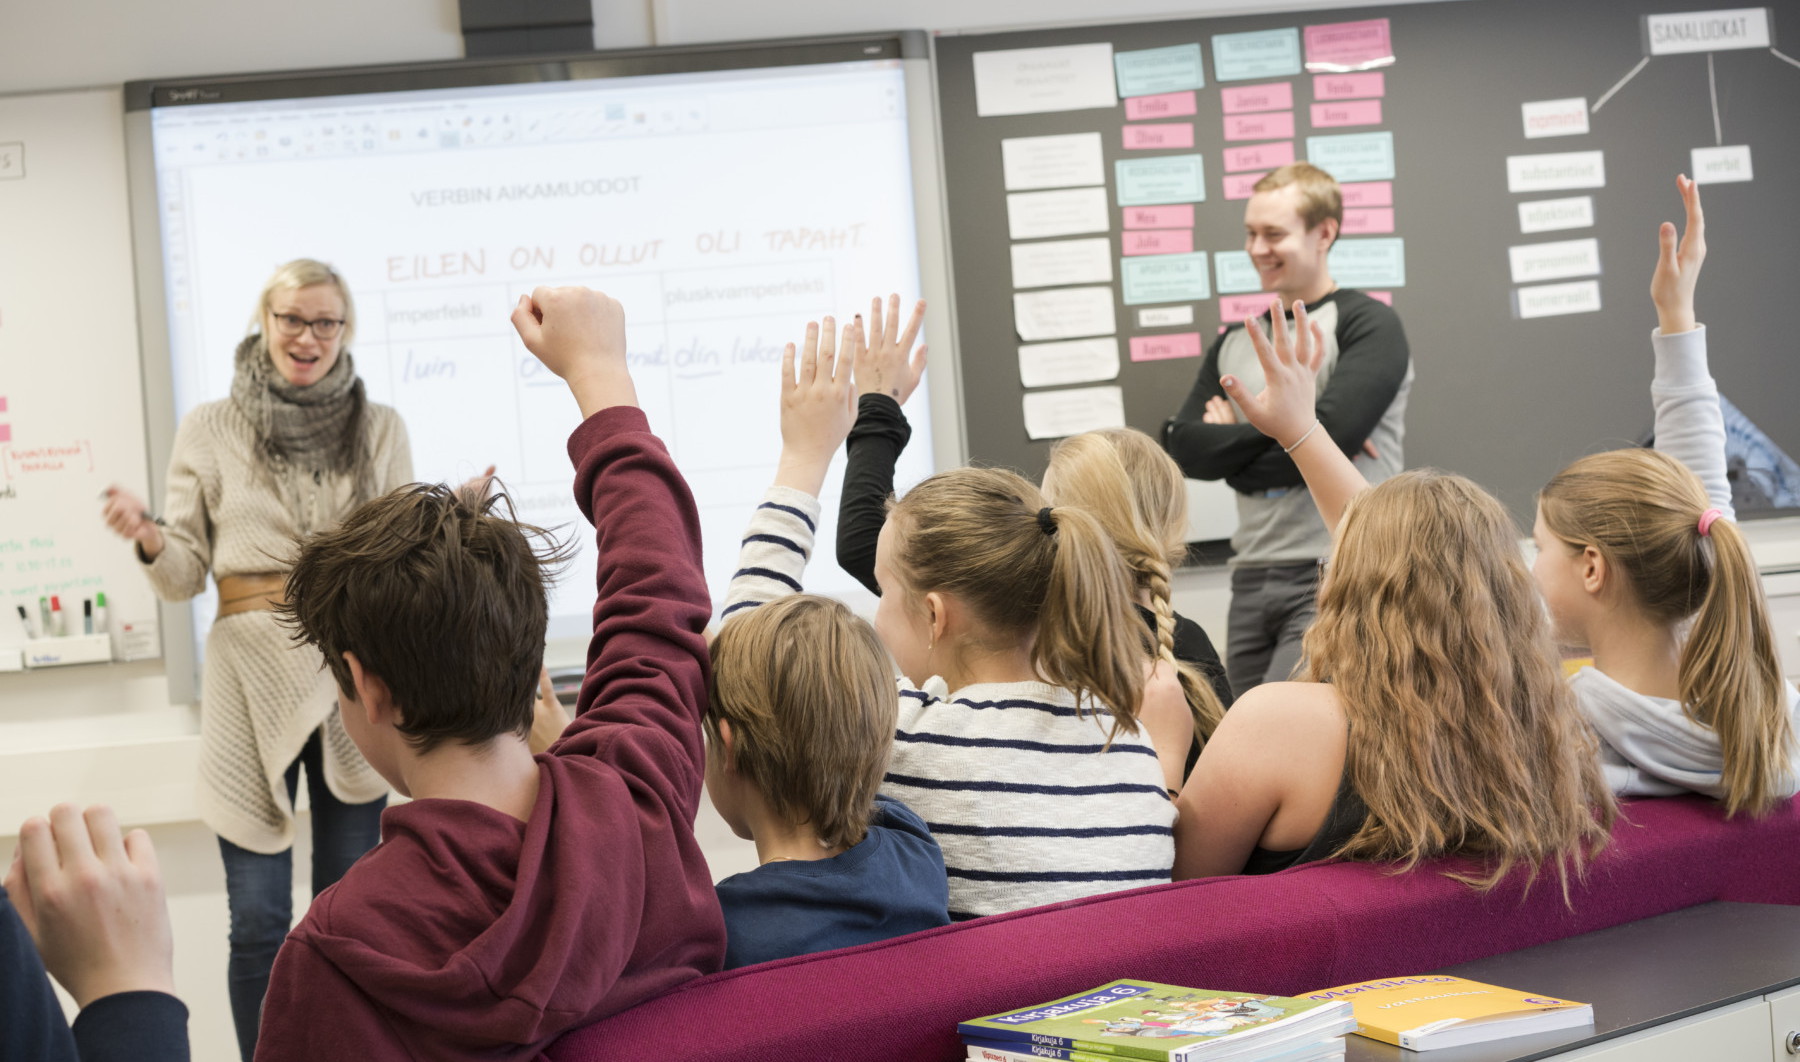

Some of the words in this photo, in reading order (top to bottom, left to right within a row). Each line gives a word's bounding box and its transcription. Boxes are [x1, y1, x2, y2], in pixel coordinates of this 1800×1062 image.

[1653, 17, 1747, 43] SANALUOKAT
[411, 187, 492, 207] VERBIN
[497, 176, 642, 201] AIKAMUODOT
[386, 249, 486, 282] EILEN
[510, 246, 555, 271] ON
[579, 240, 664, 266] OLLUT
[696, 229, 742, 253] OLI
[665, 279, 825, 307] pluskvamperfekti
[388, 303, 483, 325] imperfekti
[674, 337, 720, 368] olin
[402, 350, 457, 384] luin
[1309, 977, 1458, 1000] Matikka
[998, 995, 1116, 1023] Kirjakuja
[1110, 987, 1137, 995] 6
[1031, 1033, 1057, 1046] Kirjakuja
[1058, 1037, 1064, 1046] 6
[1031, 1045, 1056, 1058] Kirjakuja
[1056, 1049, 1062, 1058] 6
